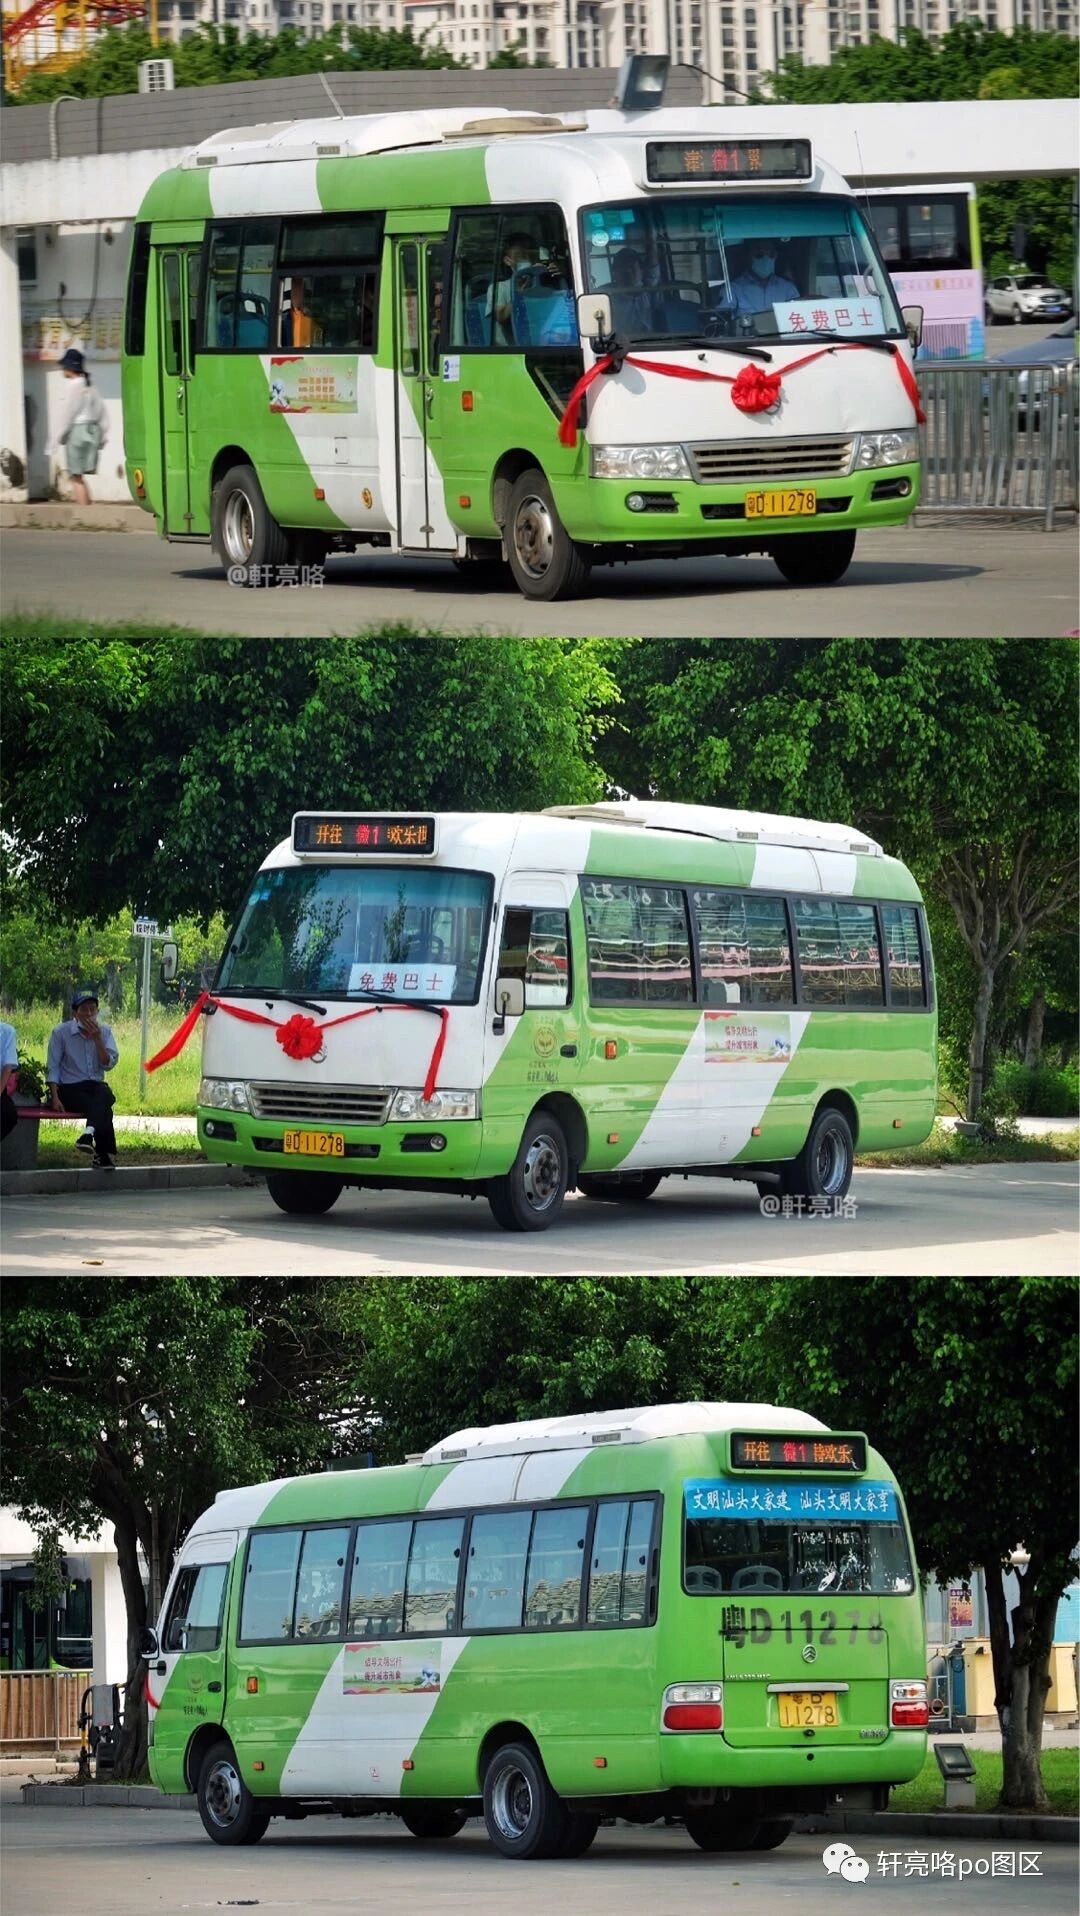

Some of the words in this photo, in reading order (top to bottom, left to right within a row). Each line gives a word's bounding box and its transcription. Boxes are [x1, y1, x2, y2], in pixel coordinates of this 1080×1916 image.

[788, 307, 874, 333] 免费巴士
[316, 824, 343, 845] 开往
[355, 824, 381, 846] 微1
[360, 971, 443, 992] 免费巴士
[744, 1441, 771, 1462] 开往
[783, 1441, 807, 1463] 微1
[693, 1488, 791, 1512] 文明汕头大家建
[800, 1489, 889, 1513] 汕头文明大家享
[784, 1705, 834, 1725] 11278
